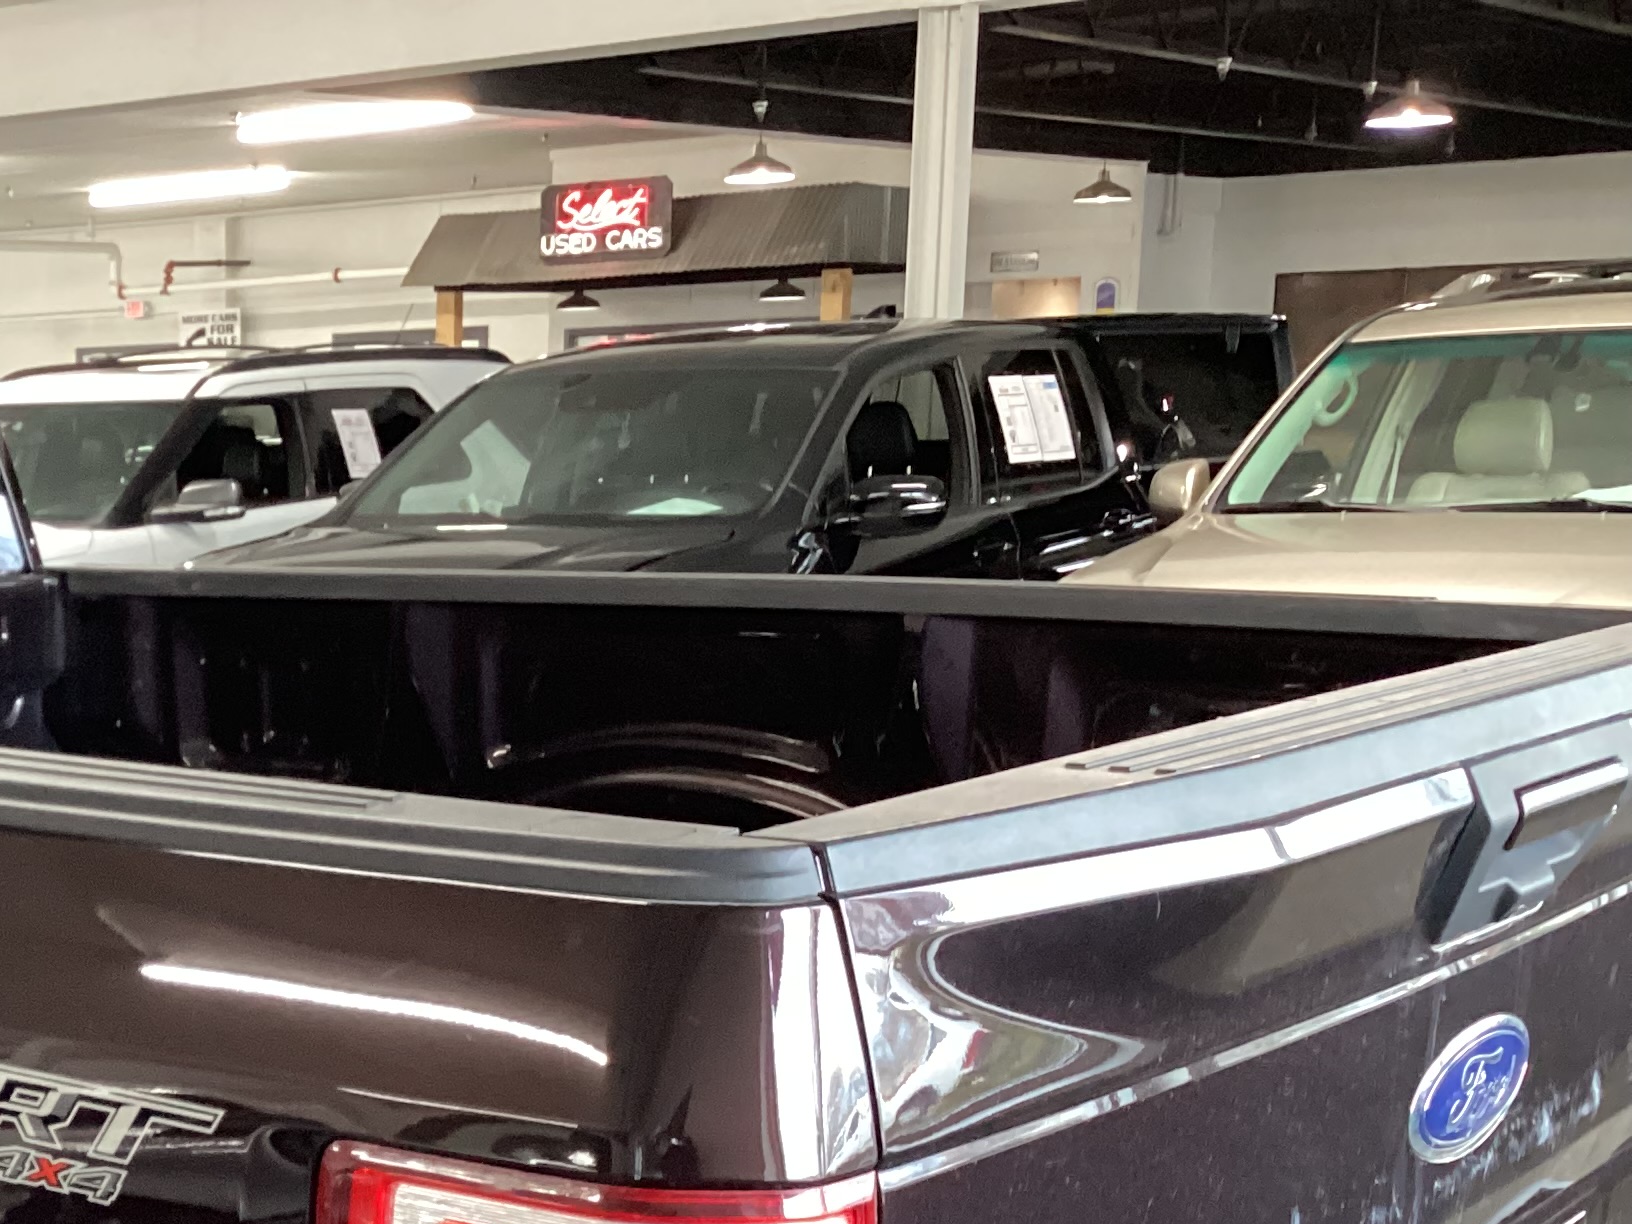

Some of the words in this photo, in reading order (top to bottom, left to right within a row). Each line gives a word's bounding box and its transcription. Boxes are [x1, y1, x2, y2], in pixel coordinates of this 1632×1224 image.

[556, 187, 647, 231] Select
[540, 232, 597, 256] USED
[605, 226, 663, 251] CARS
[210, 323, 234, 335] FOR
